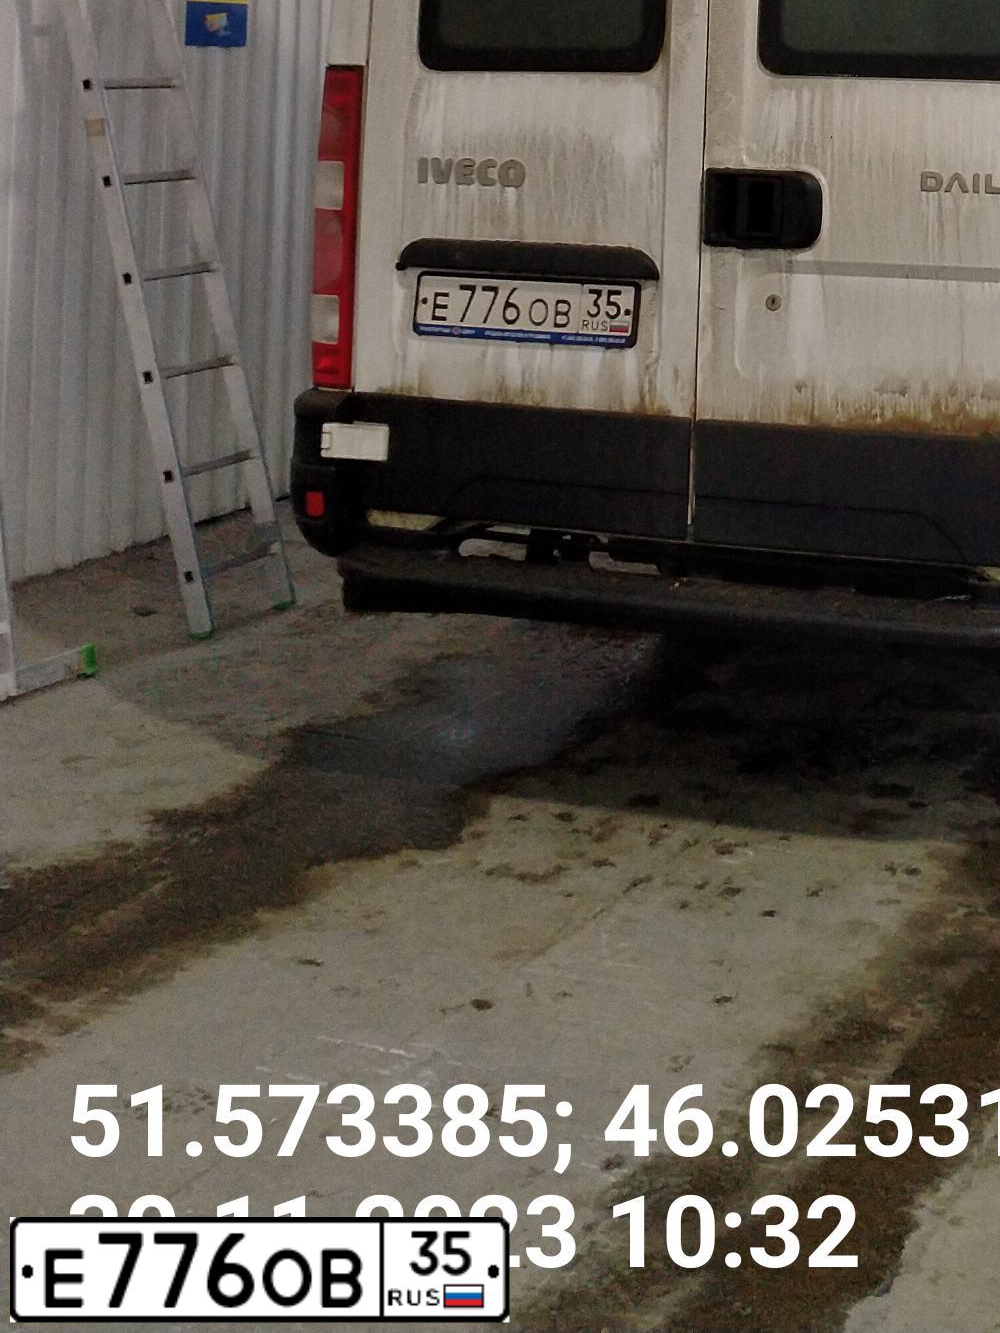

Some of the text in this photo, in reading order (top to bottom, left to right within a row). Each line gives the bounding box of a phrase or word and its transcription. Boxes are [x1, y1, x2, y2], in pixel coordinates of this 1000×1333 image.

[417, 156, 526, 188] IVECO
[586, 288, 623, 319] 35
[581, 319, 608, 332] RUS
